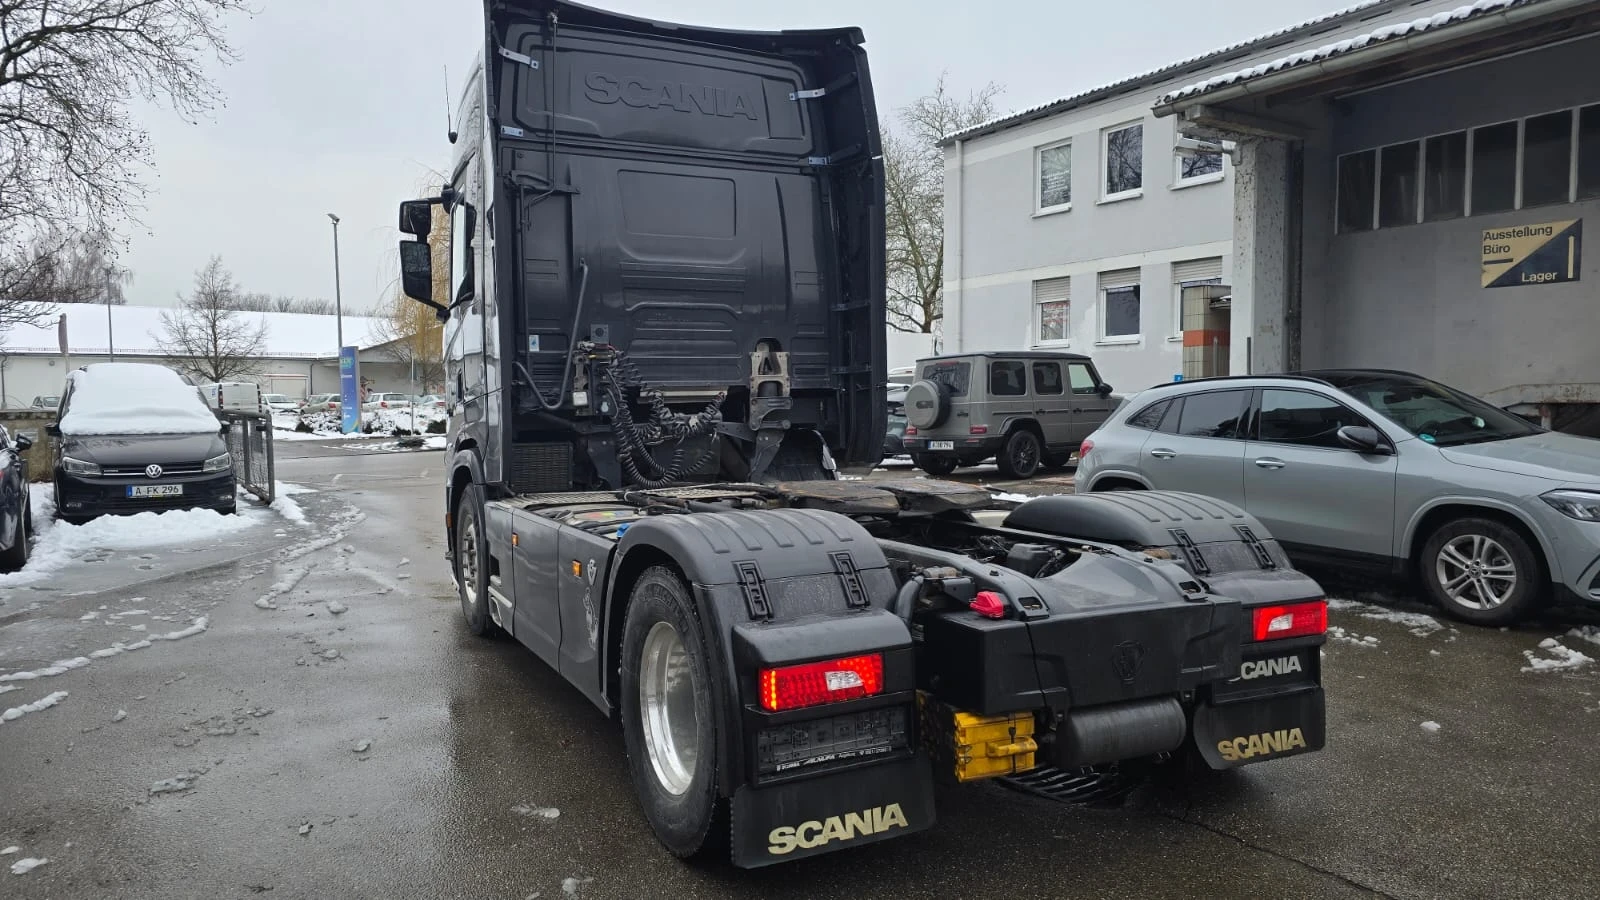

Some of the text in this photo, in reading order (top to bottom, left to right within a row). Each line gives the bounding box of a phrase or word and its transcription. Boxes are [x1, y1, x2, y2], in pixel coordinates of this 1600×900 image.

[585, 71, 757, 121] SCANIA
[1483, 226, 1552, 241] Ausstellung
[1483, 244, 1511, 255] Büro
[1521, 271, 1558, 283] Lager
[135, 485, 179, 495] A FK 296
[1228, 655, 1302, 682] CANIA
[1217, 727, 1306, 760] SCANIA
[767, 802, 909, 855] SCANIA
